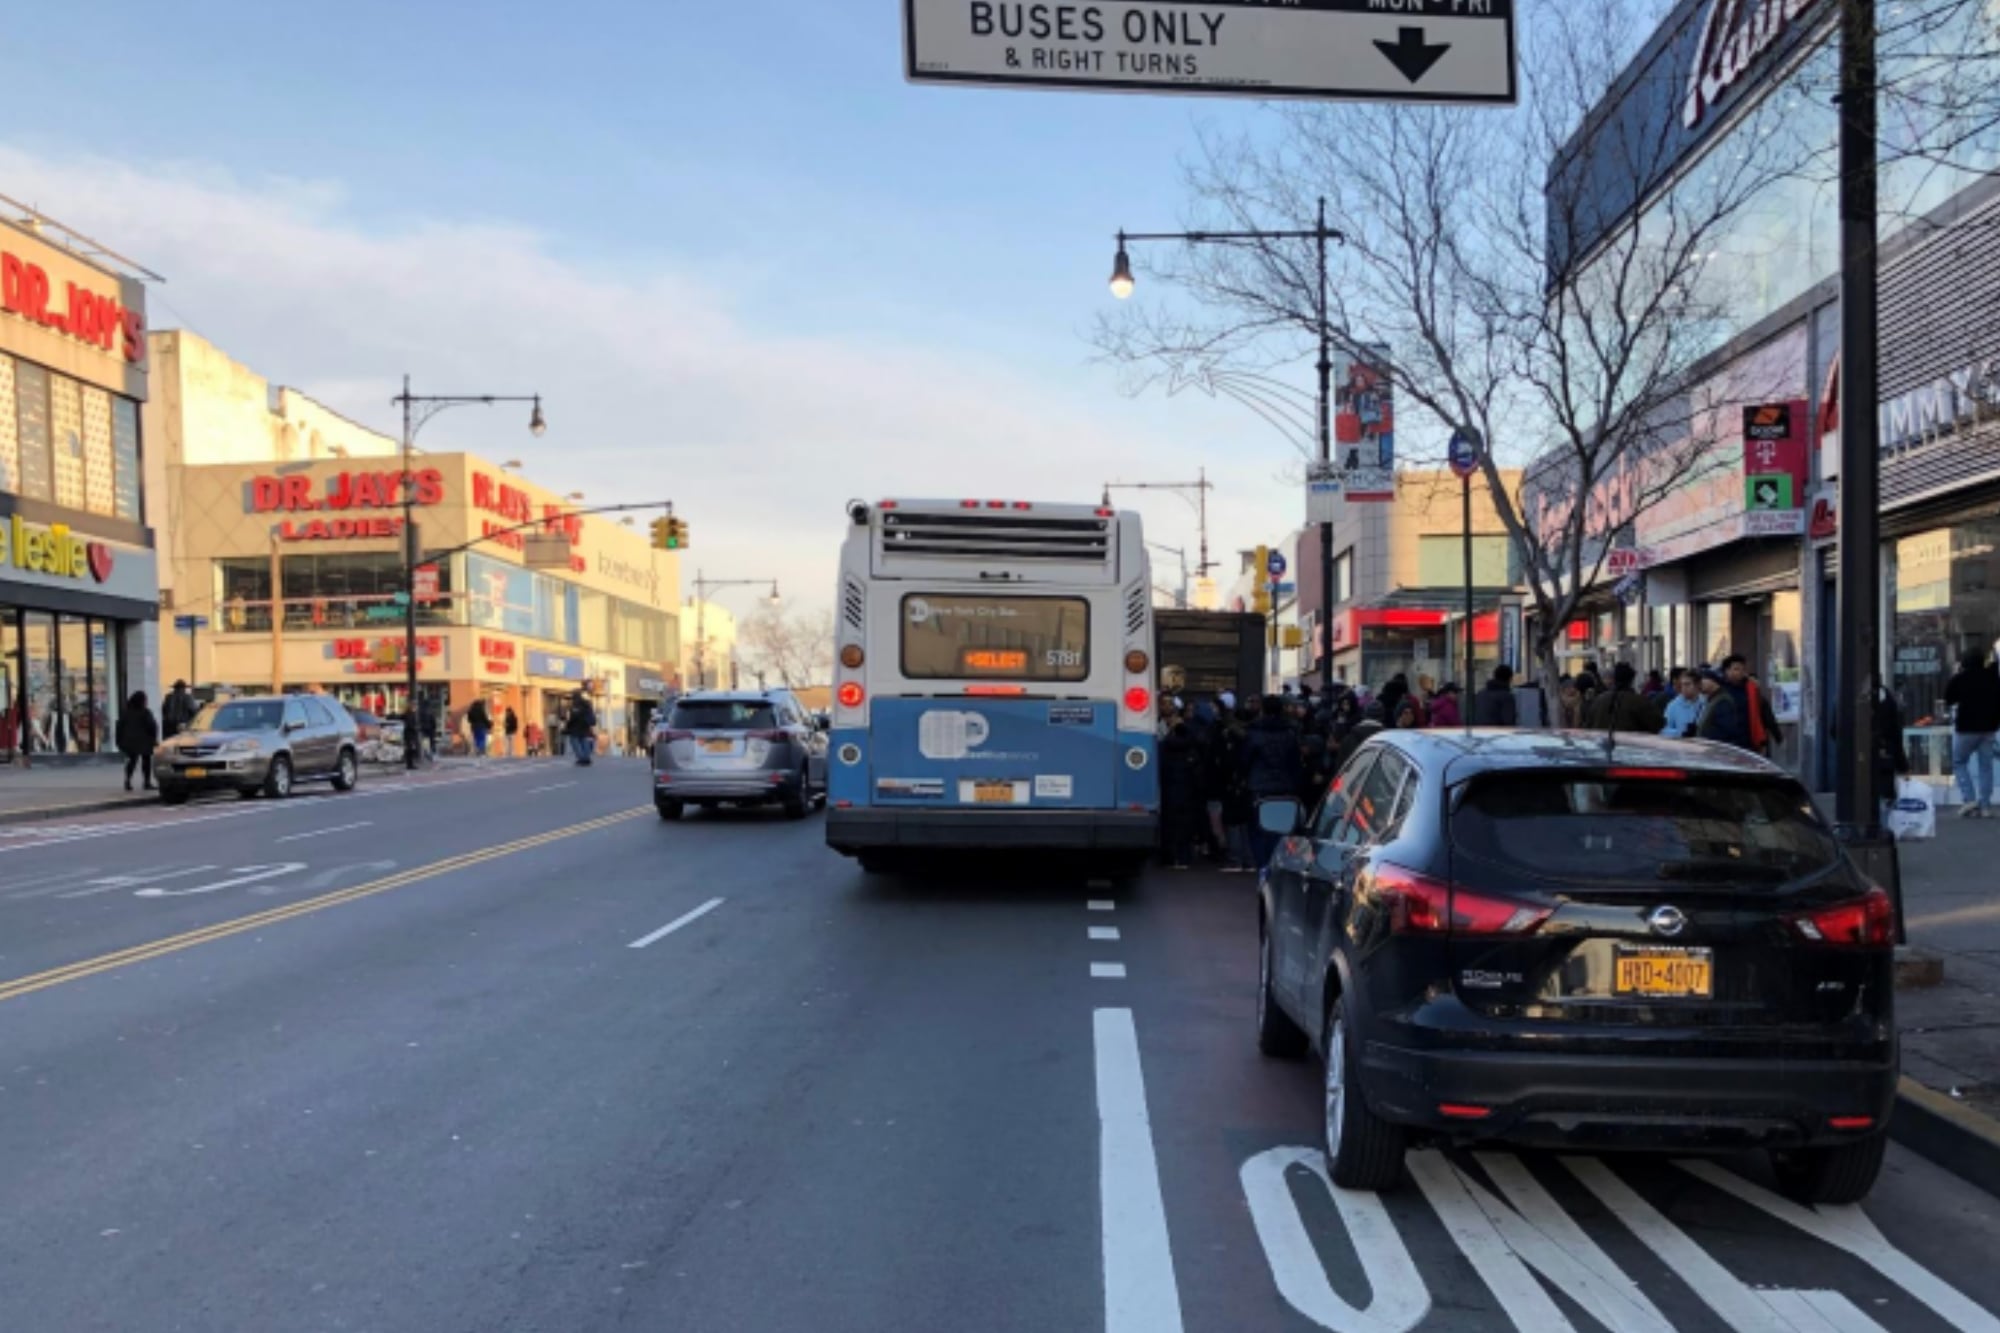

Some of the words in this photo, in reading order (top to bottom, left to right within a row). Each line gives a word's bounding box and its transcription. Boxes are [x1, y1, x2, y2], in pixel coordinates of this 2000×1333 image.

[971, 1, 1104, 41] BUSES
[1123, 9, 1225, 46] ONLY
[1005, 47, 1021, 68] &
[1033, 48, 1104, 70] RIGHT
[1116, 51, 1198, 74] TURNS
[2, 251, 59, 328] DR.
[57, 280, 145, 363] JAY'S
[252, 475, 322, 511] DR.
[327, 468, 443, 510] JAY'S
[11, 513, 86, 579] leslie
